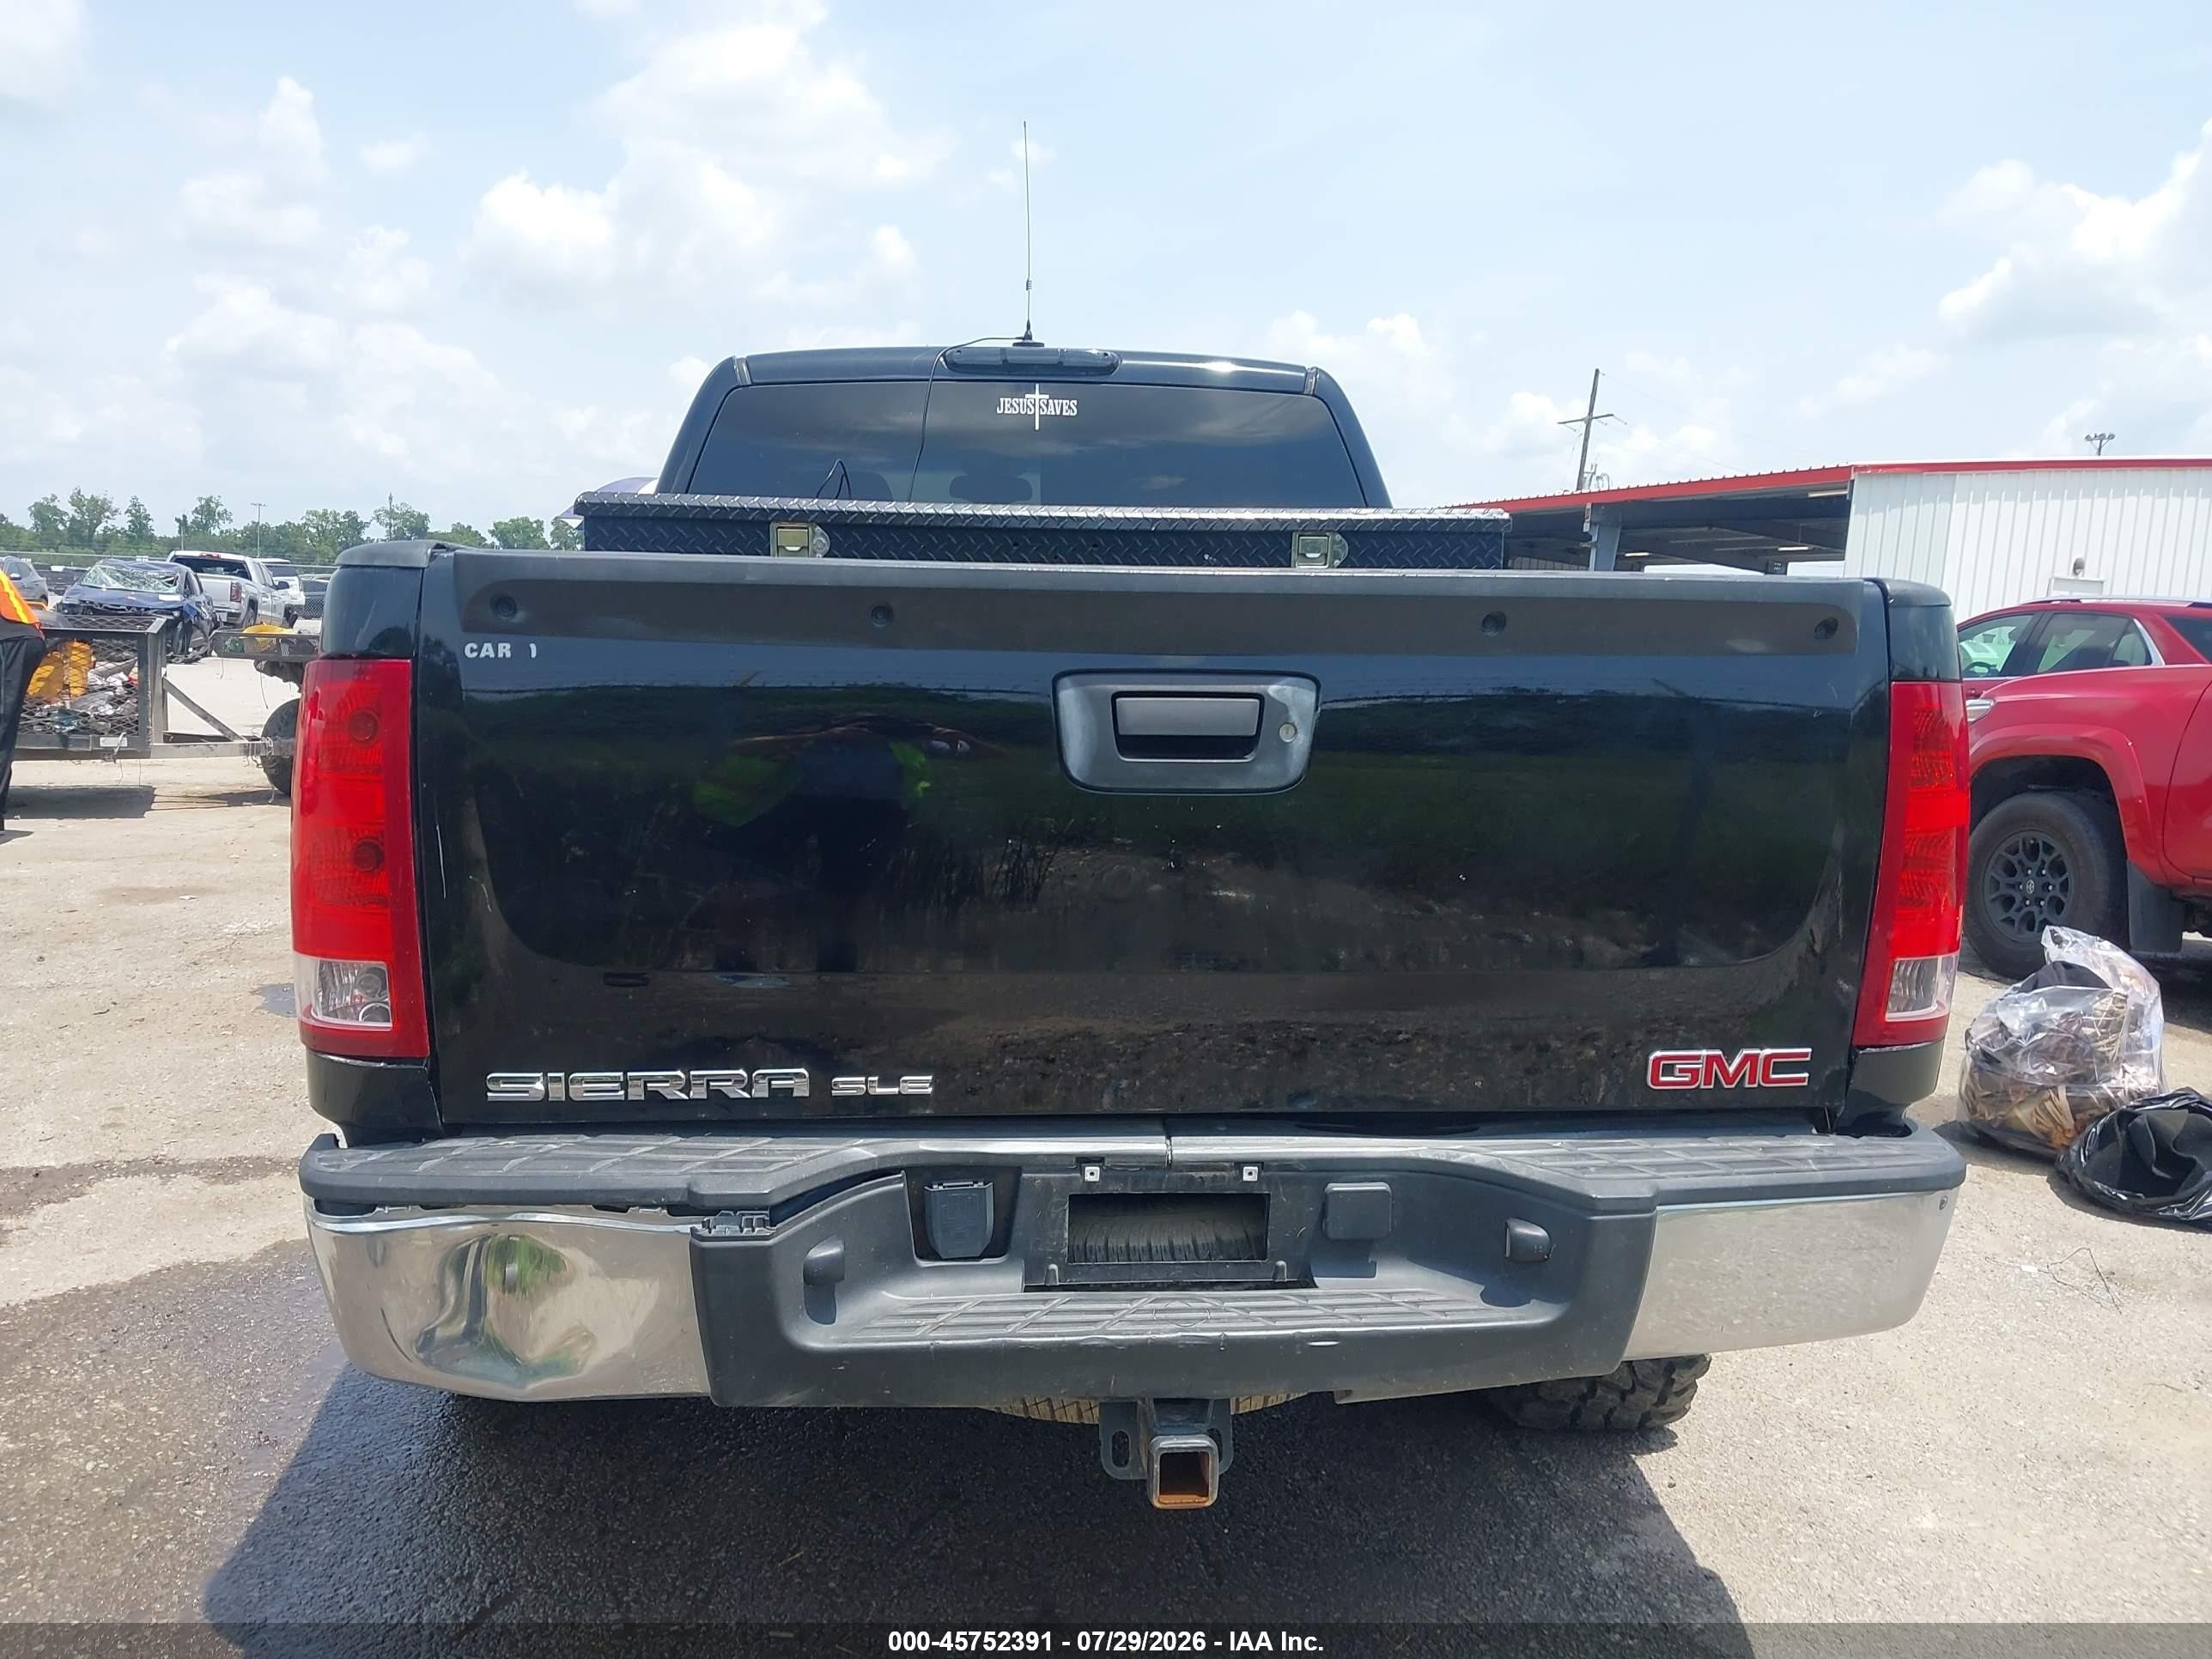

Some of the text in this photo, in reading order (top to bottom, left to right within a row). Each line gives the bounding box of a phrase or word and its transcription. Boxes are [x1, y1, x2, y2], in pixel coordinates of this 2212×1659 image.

[996, 397, 1078, 416] JESUS SAVES
[465, 642, 512, 659] CAR
[1647, 1048, 1812, 1090] GMC
[486, 1067, 933, 1102] SIERRA SLE
